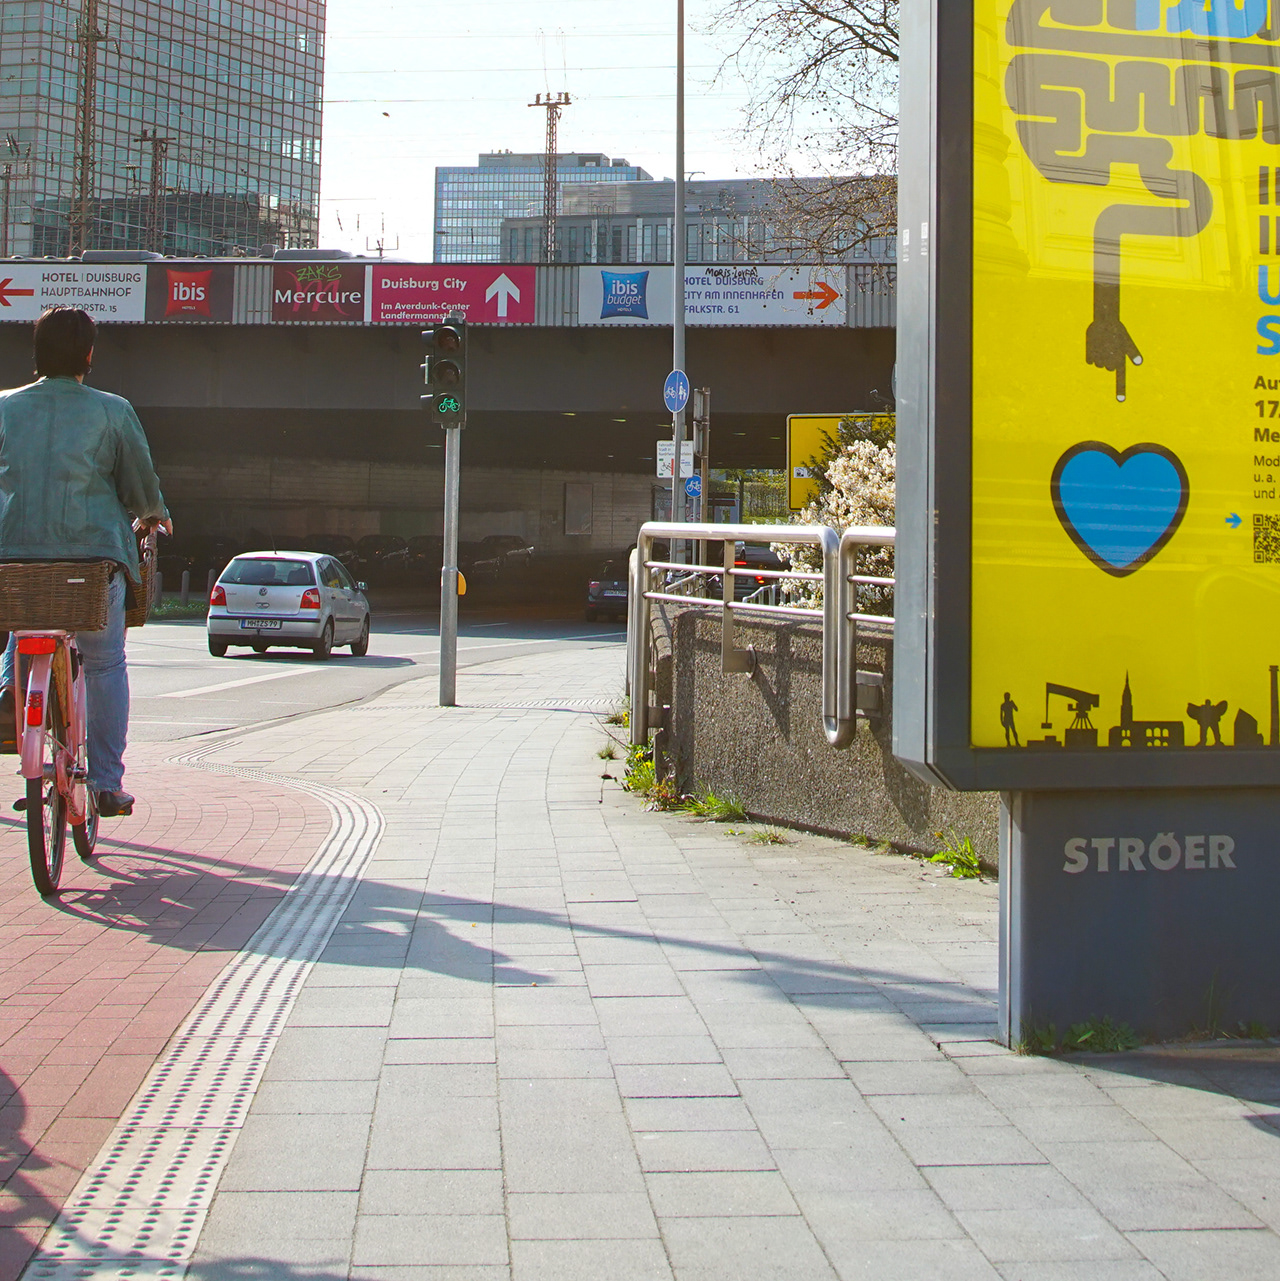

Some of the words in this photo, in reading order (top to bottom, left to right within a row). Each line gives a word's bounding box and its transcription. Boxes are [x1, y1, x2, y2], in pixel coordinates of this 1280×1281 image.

[42, 272, 78, 283] HOTEL
[86, 272, 141, 283] DUISBURG
[684, 277, 711, 286] HOTEL
[716, 277, 764, 286] DUISBURG
[382, 278, 439, 291] Duisburg
[443, 278, 467, 291] City
[611, 279, 638, 295] ibis
[41, 287, 131, 297] HAUPTBAHNHOF
[173, 282, 205, 301] ibis
[275, 289, 361, 304] Mercure
[705, 291, 720, 299] AM
[607, 293, 642, 307] budget
[40, 303, 107, 312] MERTORSTR.
[381, 302, 392, 310] Im
[395, 302, 470, 310] Averdunk-Center
[684, 305, 726, 314] FALKSTR.
[728, 305, 740, 314] 61
[1253, 488, 1276, 499] und
[1063, 832, 1237, 873] STRÖER
